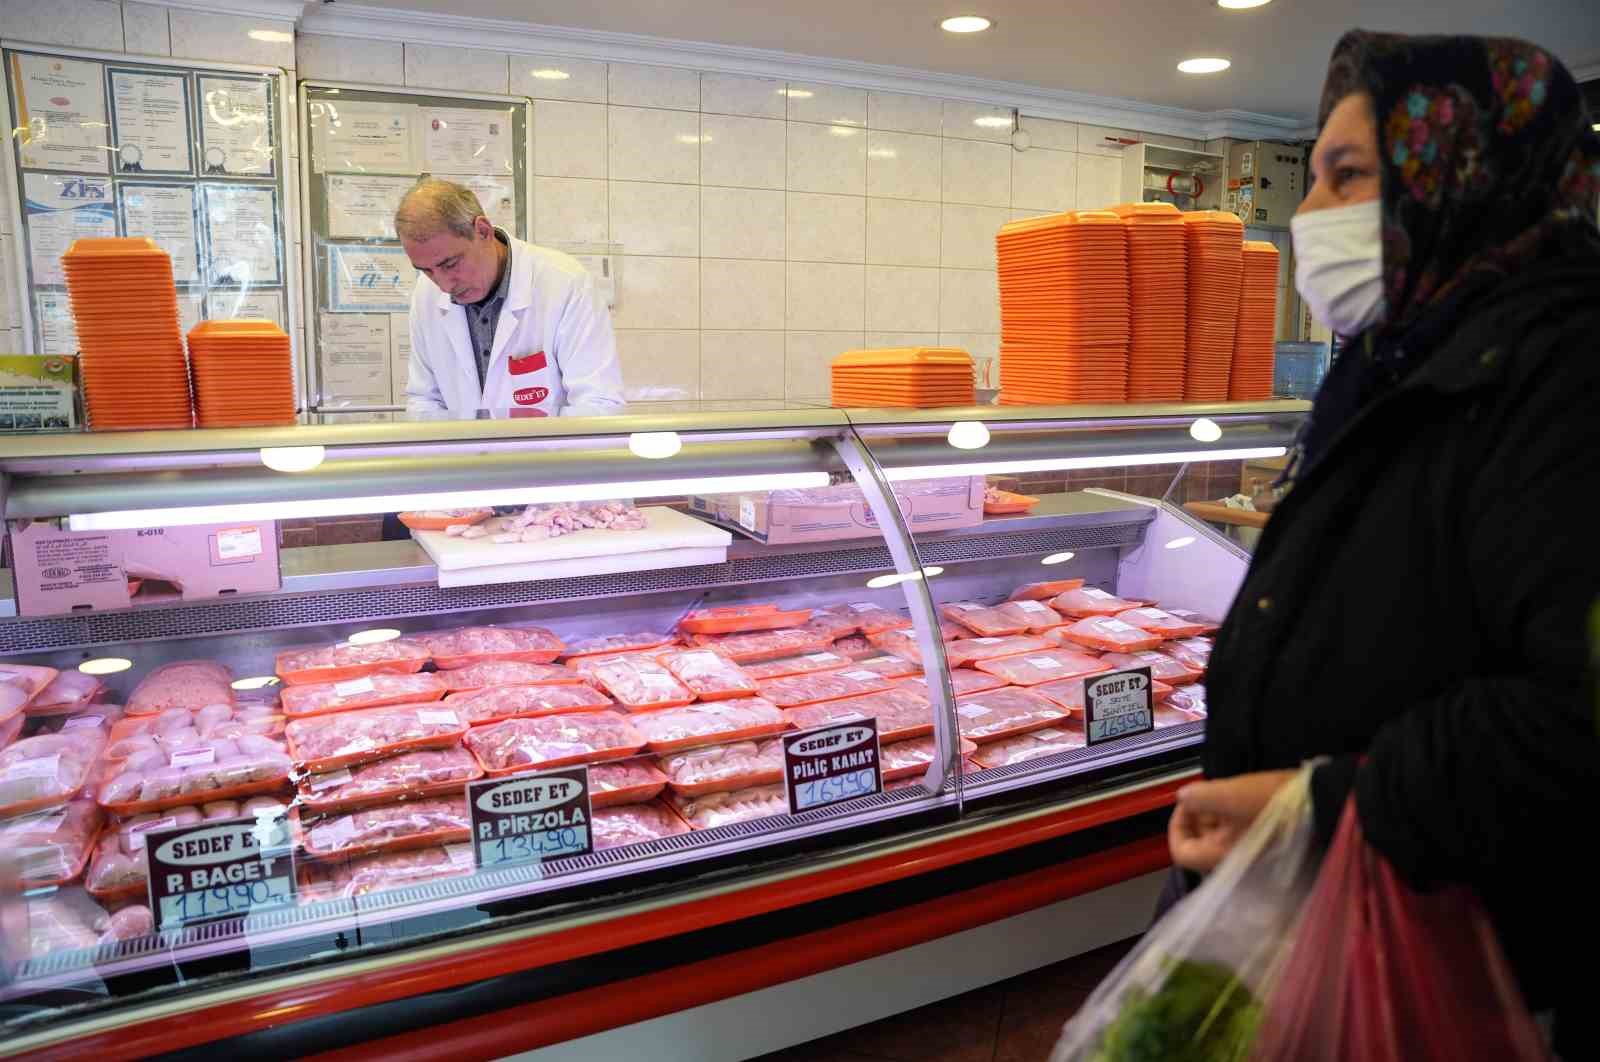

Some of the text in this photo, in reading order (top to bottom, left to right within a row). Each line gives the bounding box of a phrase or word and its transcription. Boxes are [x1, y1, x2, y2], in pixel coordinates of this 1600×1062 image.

[1096, 677, 1142, 697] SEDEF ET
[799, 729, 864, 753] SEDEF ET
[793, 749, 874, 780] PİLİÇ KANAT
[491, 782, 570, 809] SEDEF ET
[172, 834, 234, 860] SEDEF
[191, 858, 276, 890] BAGET
